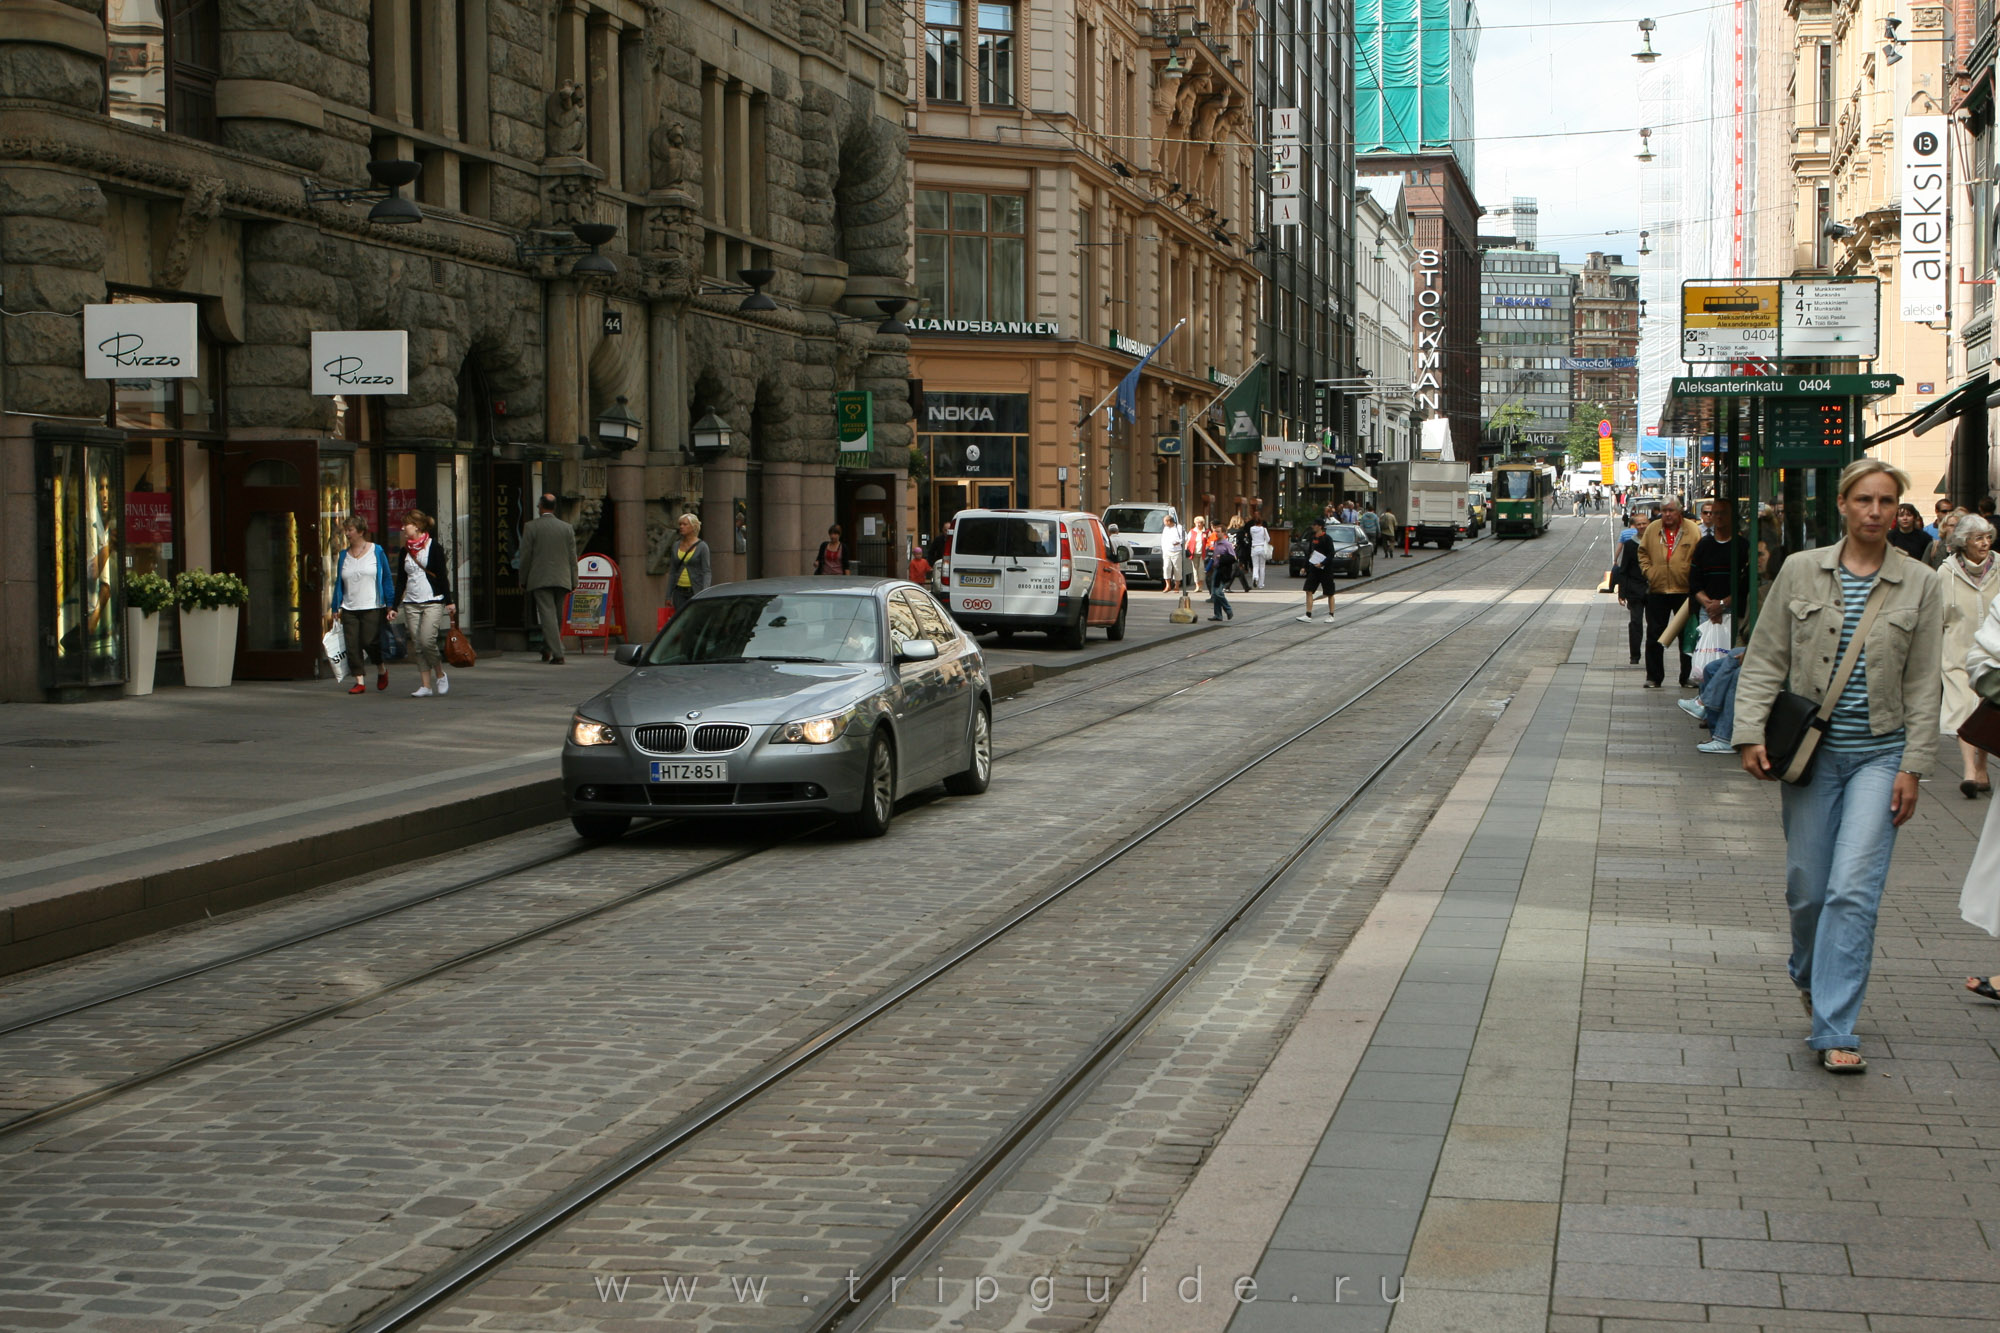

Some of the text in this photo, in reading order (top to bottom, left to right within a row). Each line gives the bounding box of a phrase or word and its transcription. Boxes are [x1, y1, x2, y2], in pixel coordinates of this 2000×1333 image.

[1280, 114, 1291, 219] MODA
[1904, 136, 1942, 281] aleksi 13
[1795, 285, 1805, 298] 4
[1492, 296, 1552, 307] FISKARS
[1903, 304, 1935, 316] aleksi
[605, 318, 620, 331] 44
[1418, 249, 1440, 418] STOCKMAN
[1742, 329, 1776, 341] 0404
[98, 331, 181, 367] Rizzo
[323, 354, 394, 386] Rizzo
[1677, 379, 1891, 393] Aleksanterinkatu 0404 1364
[928, 406, 995, 421] NOKIA
[1526, 433, 1554, 444] Aktia
[125, 503, 169, 516] FINAL SALE
[497, 484, 509, 576] TUPAKKAA
[964, 575, 991, 584] GHI-757
[963, 598, 992, 610] TNT
[662, 764, 721, 779] HTZ-851
